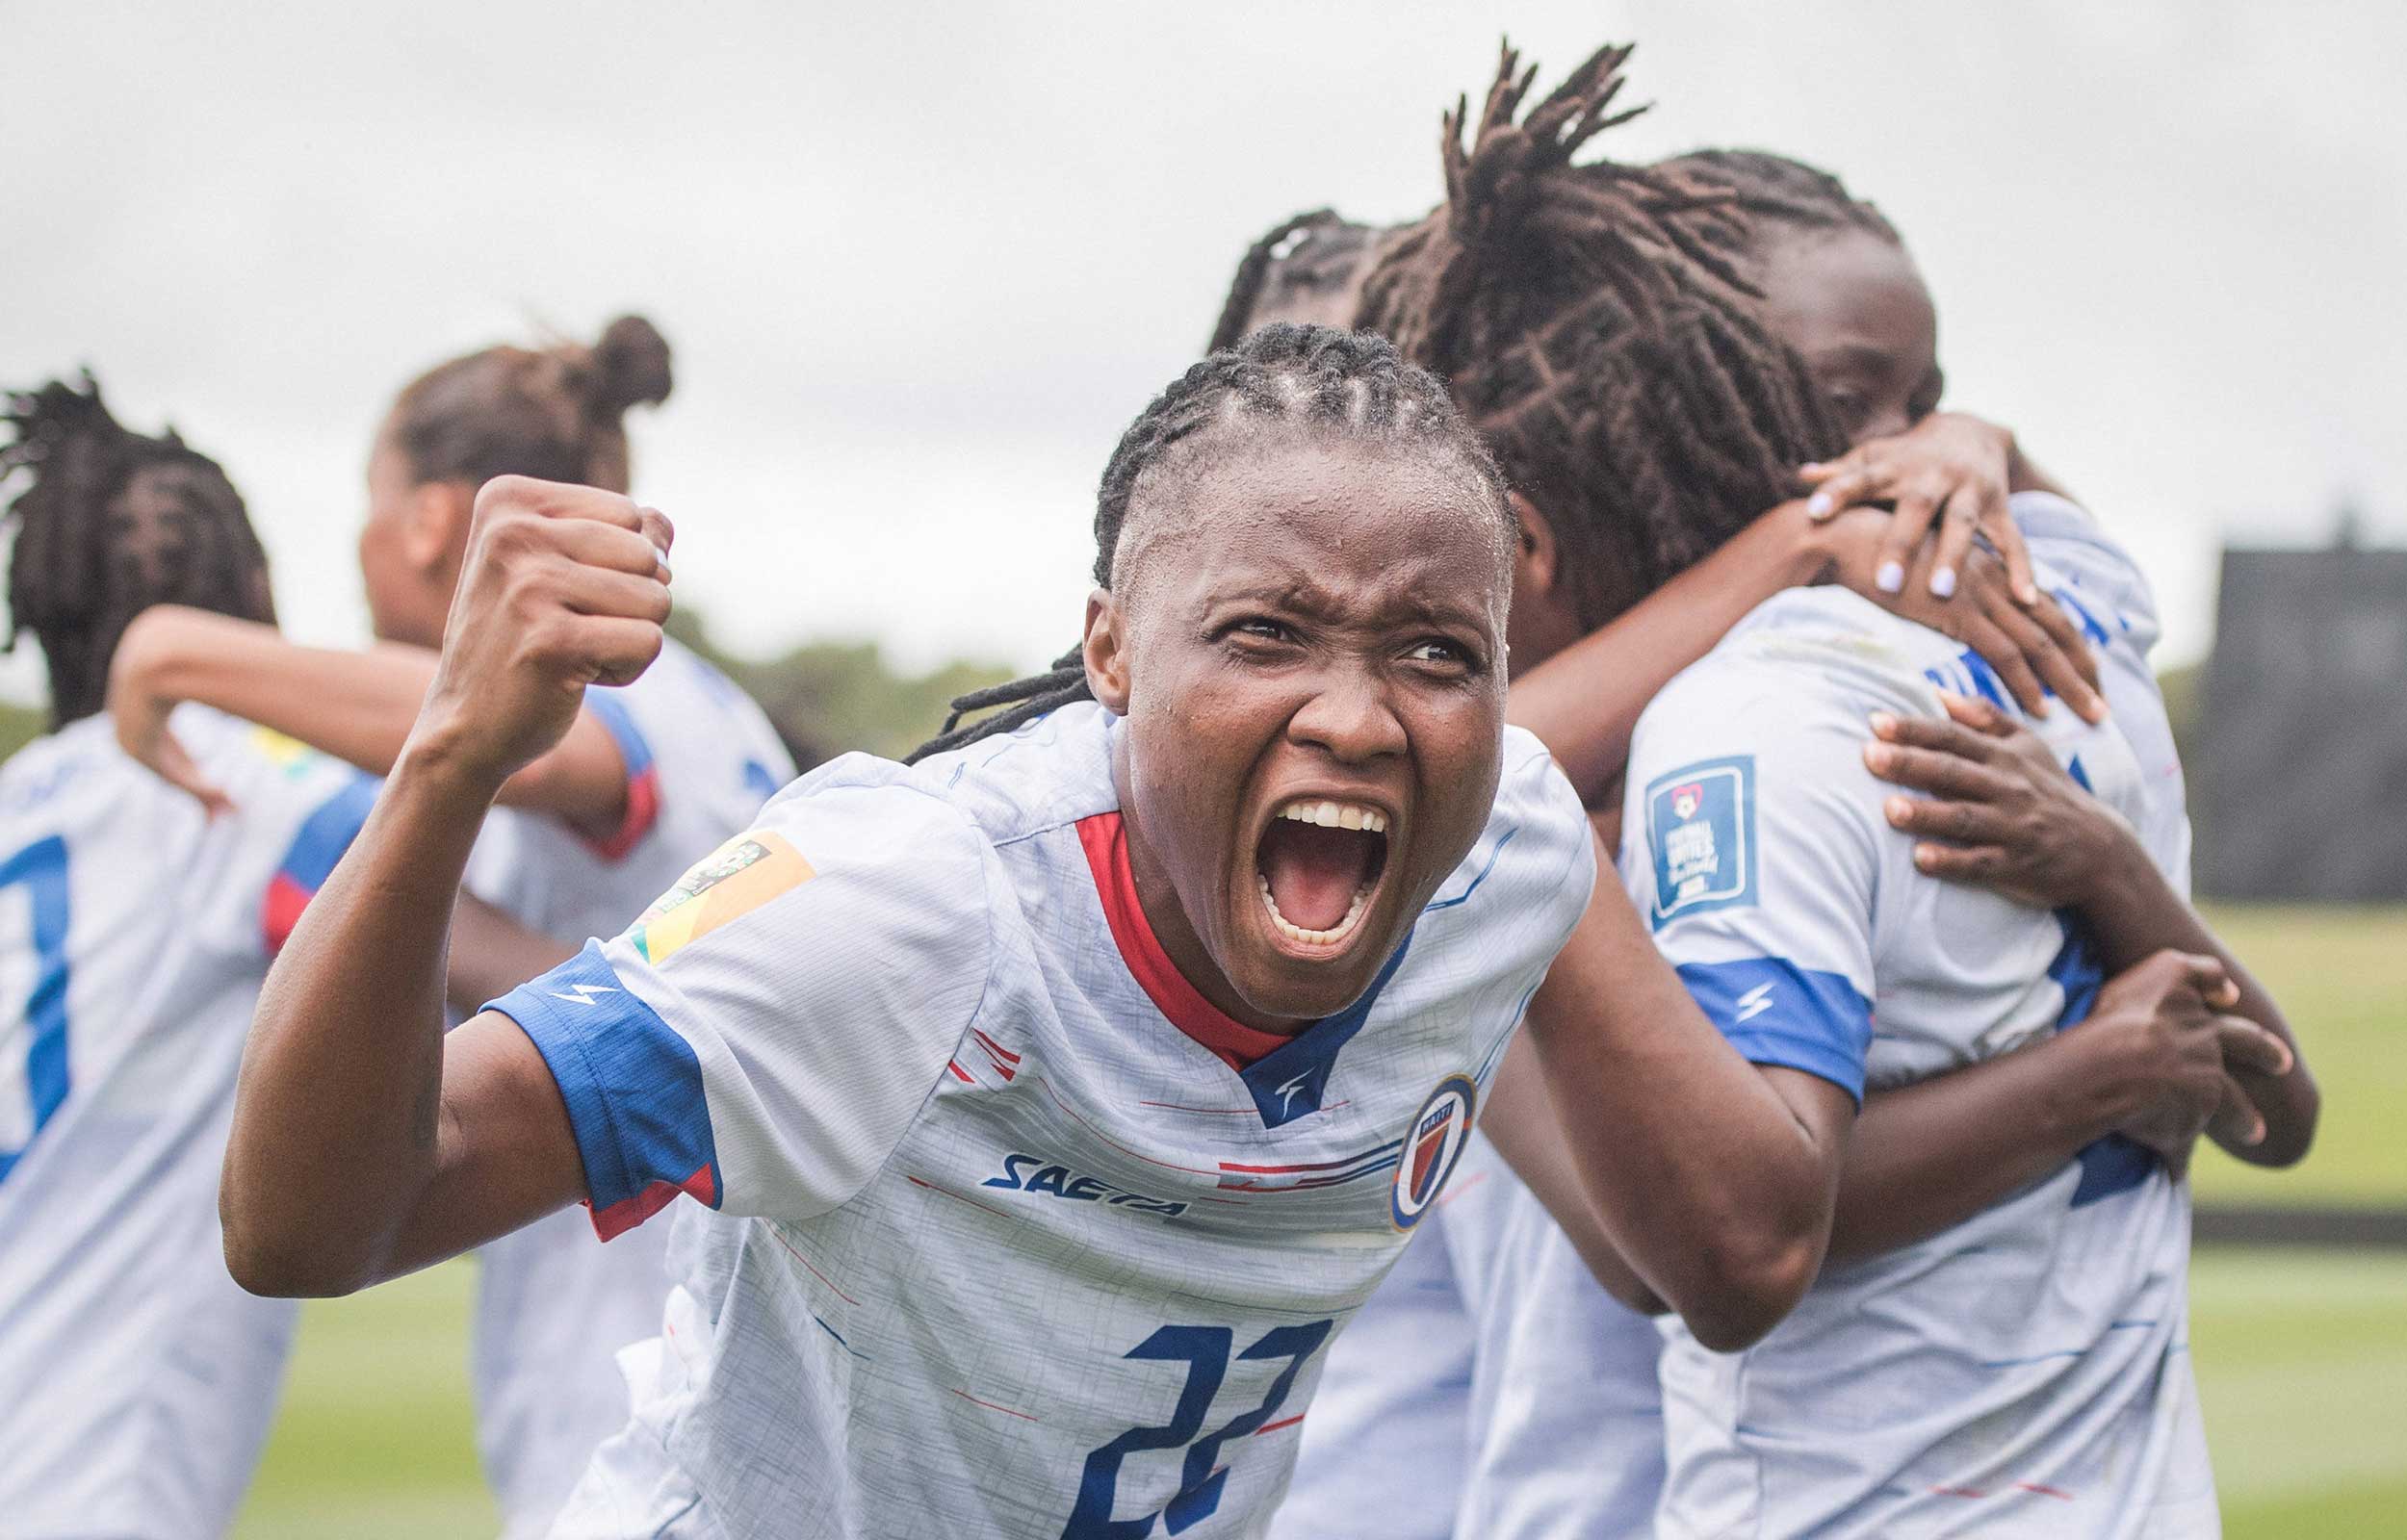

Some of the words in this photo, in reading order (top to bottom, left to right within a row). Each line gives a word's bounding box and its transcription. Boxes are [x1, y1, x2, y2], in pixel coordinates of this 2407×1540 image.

[1422, 1103, 1452, 1133] HAITI
[981, 1153, 1189, 1217] SAETA
[1060, 1319, 1333, 1540] 22
